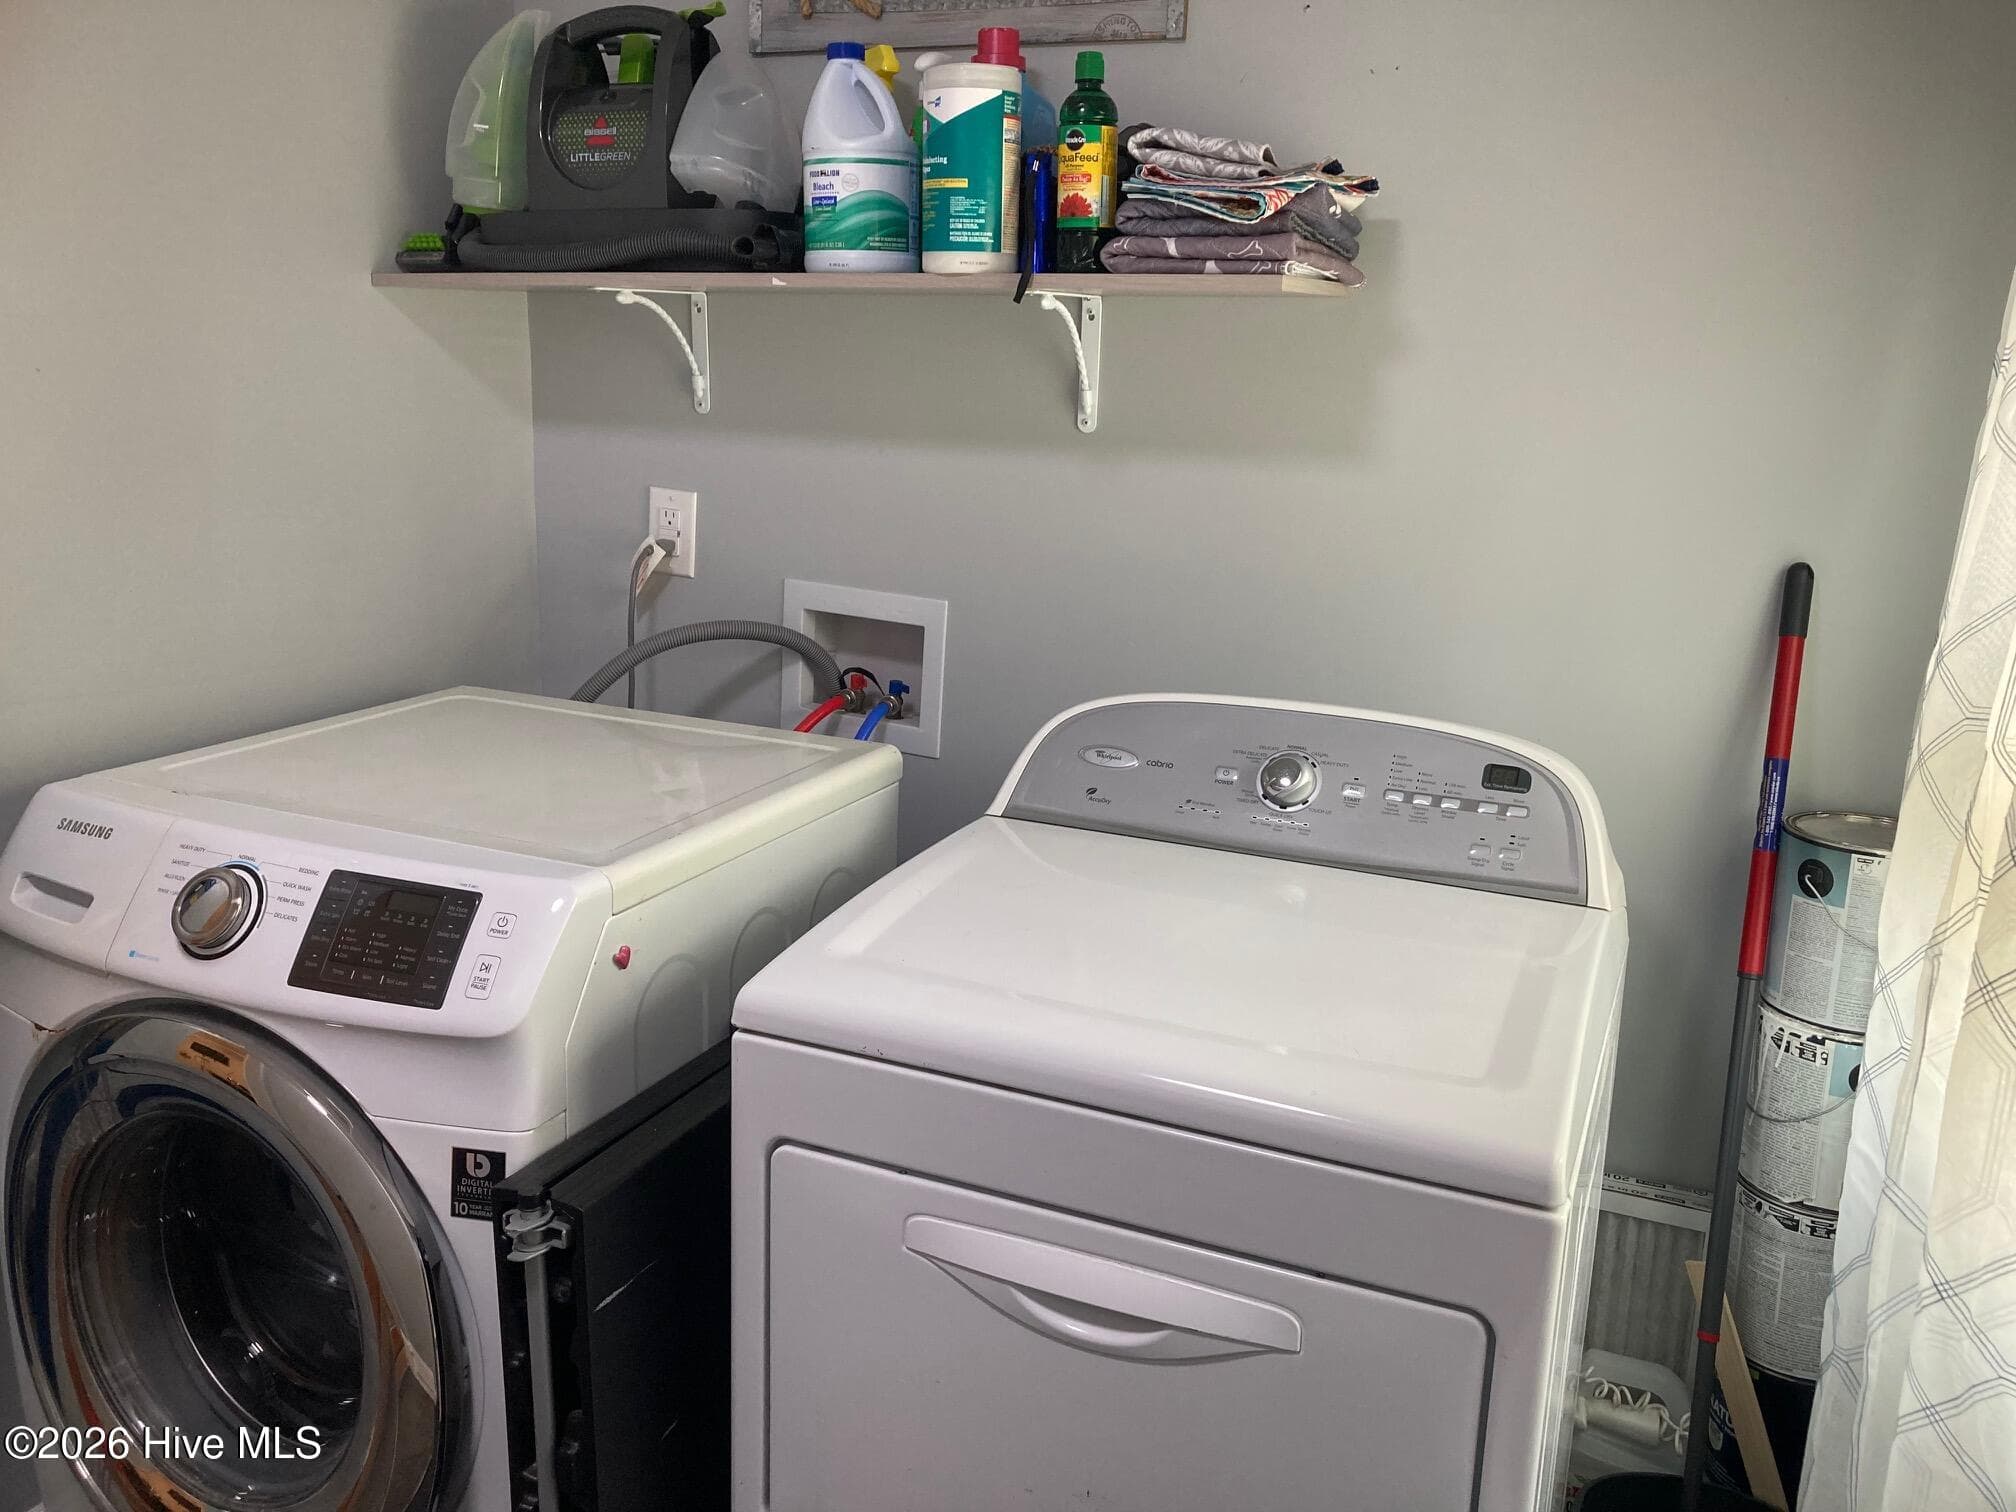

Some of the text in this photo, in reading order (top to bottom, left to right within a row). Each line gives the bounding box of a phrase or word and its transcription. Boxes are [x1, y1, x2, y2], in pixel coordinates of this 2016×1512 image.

[570, 151, 631, 163] LITTLEGREEN
[1060, 152, 1099, 166] quaFeed
[812, 182, 835, 191] Bleach
[1146, 759, 1174, 769] cabrio
[57, 817, 114, 840] SAMSUNG
[298, 867, 320, 876] BEDDING
[282, 881, 312, 892] QUICK WASH
[277, 896, 305, 907] PERM PRESS
[274, 912, 298, 923] DELICATES
[489, 928, 509, 936] POWER
[473, 975, 491, 984] START
[470, 983, 488, 991] PAUSE
[461, 1178, 494, 1188] DIGITAL
[457, 1185, 492, 1195] INVERT
[454, 1202, 469, 1215] 10
